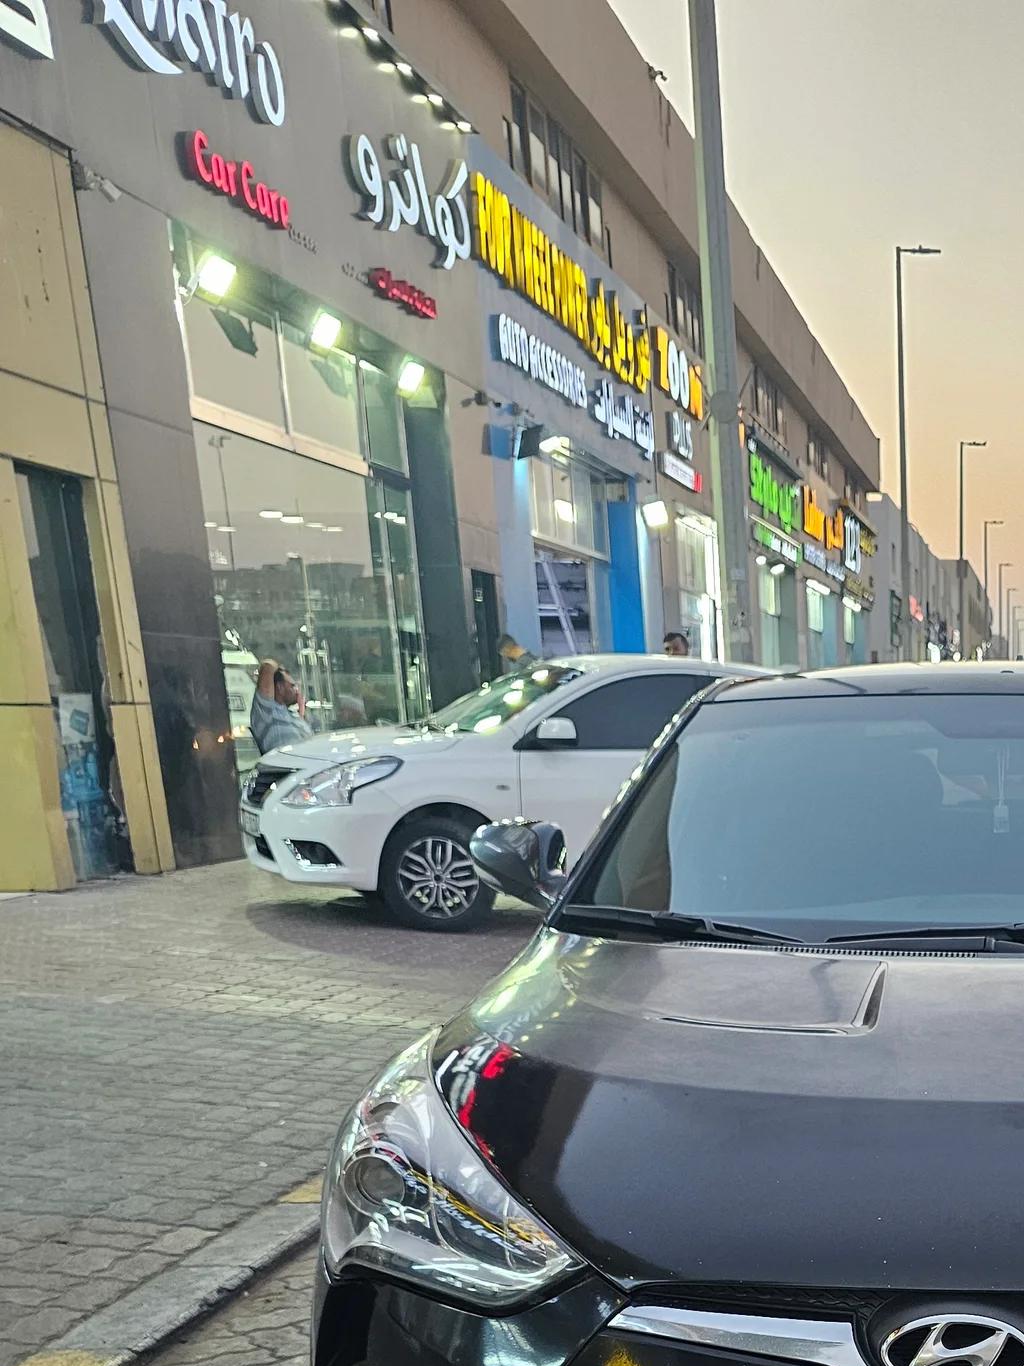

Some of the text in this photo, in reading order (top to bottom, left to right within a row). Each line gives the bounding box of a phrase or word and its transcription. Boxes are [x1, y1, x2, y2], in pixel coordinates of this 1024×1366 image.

[193, 130, 289, 230] Car Care
[357, 134, 472, 271] كواترو
[476, 171, 515, 289] FOUR
[511, 203, 555, 317] WHEEL
[498, 312, 588, 409] AUTO ACCESSORIES
